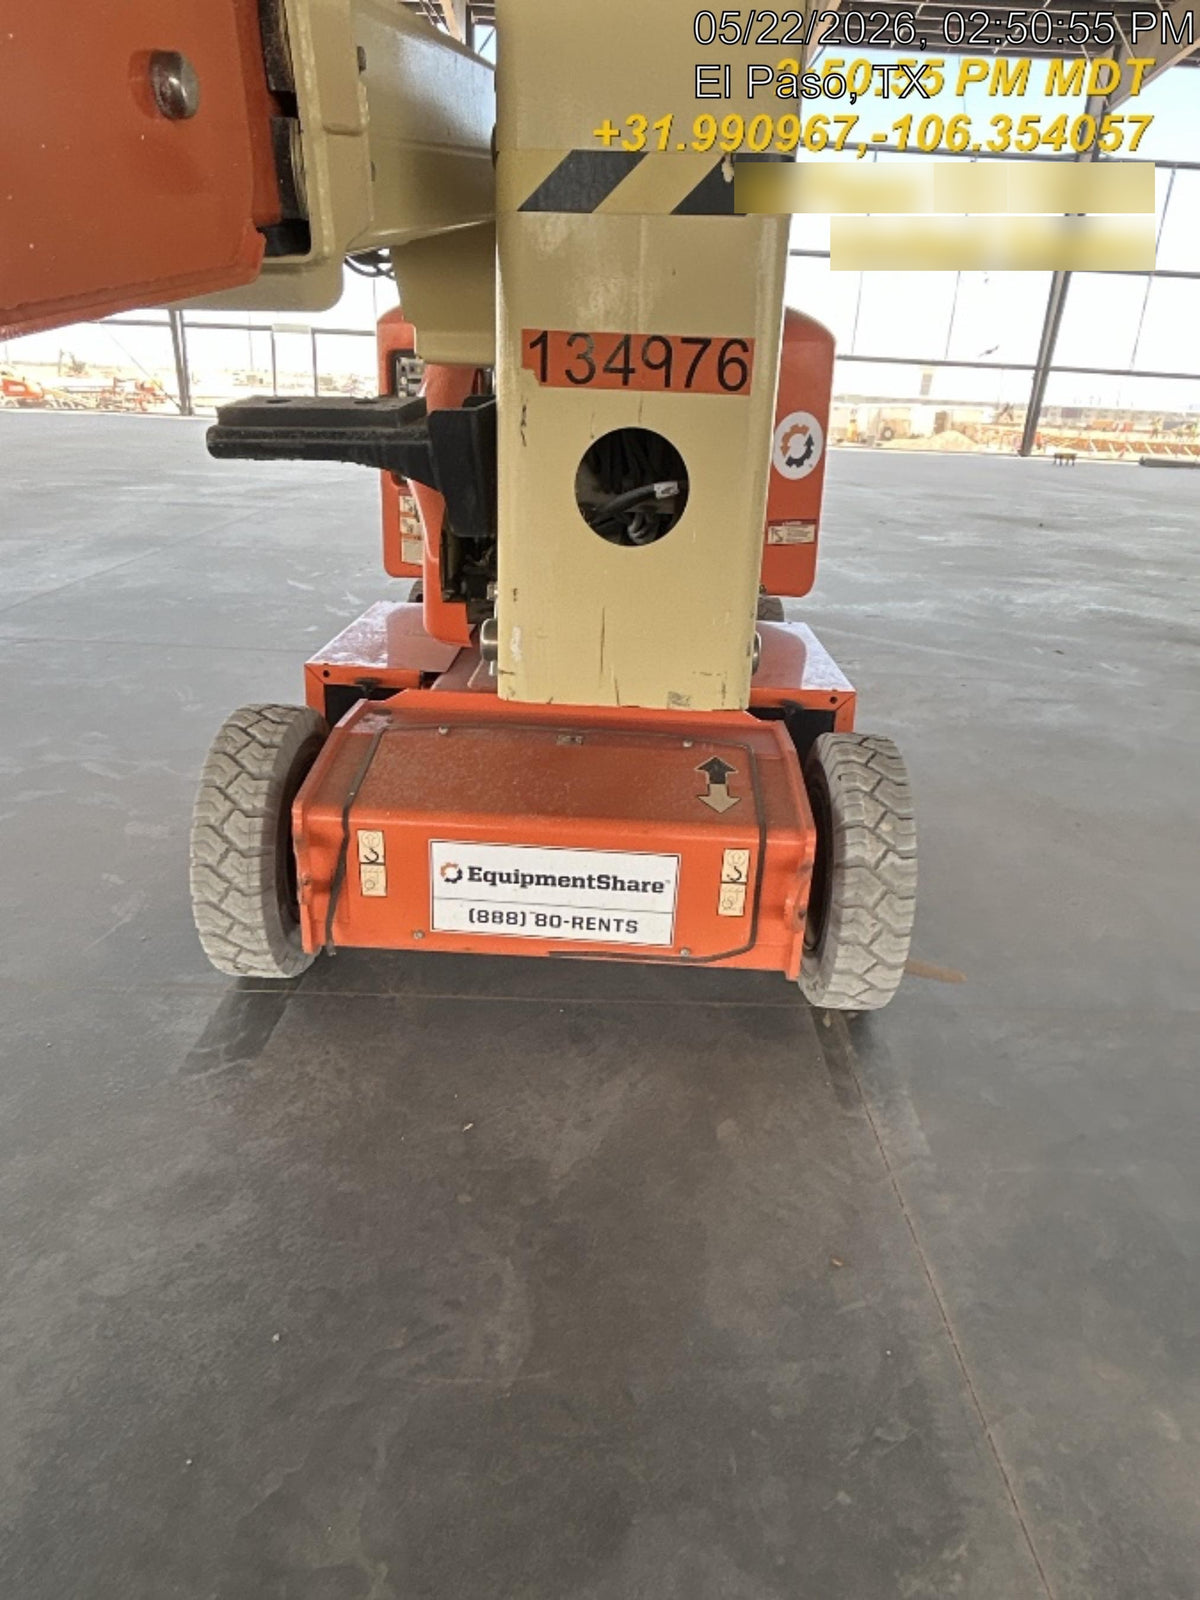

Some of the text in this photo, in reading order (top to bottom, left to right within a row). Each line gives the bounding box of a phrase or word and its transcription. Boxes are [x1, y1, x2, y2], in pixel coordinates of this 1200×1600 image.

[529, 330, 749, 392] 134976
[467, 865, 665, 894] EquipmentShare
[468, 907, 639, 933] (888) 80-RENTS
